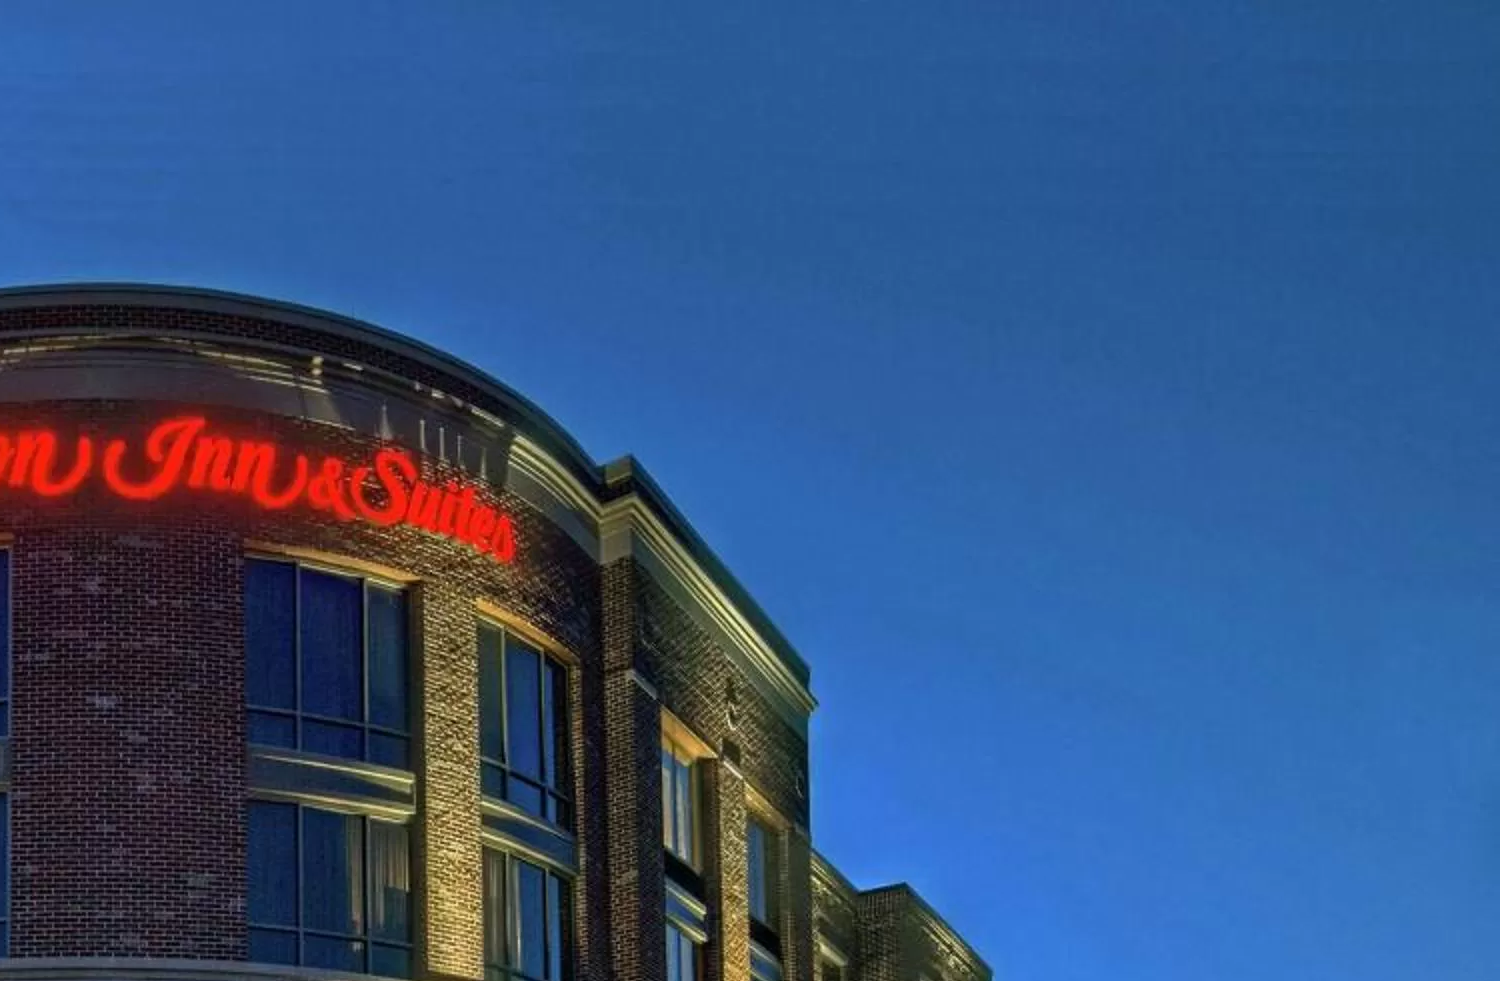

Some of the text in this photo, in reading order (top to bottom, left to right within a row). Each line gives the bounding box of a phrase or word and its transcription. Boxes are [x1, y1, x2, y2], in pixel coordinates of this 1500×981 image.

[103, 415, 308, 509] Inn
[307, 456, 358, 520] &
[352, 447, 516, 564] Suites
